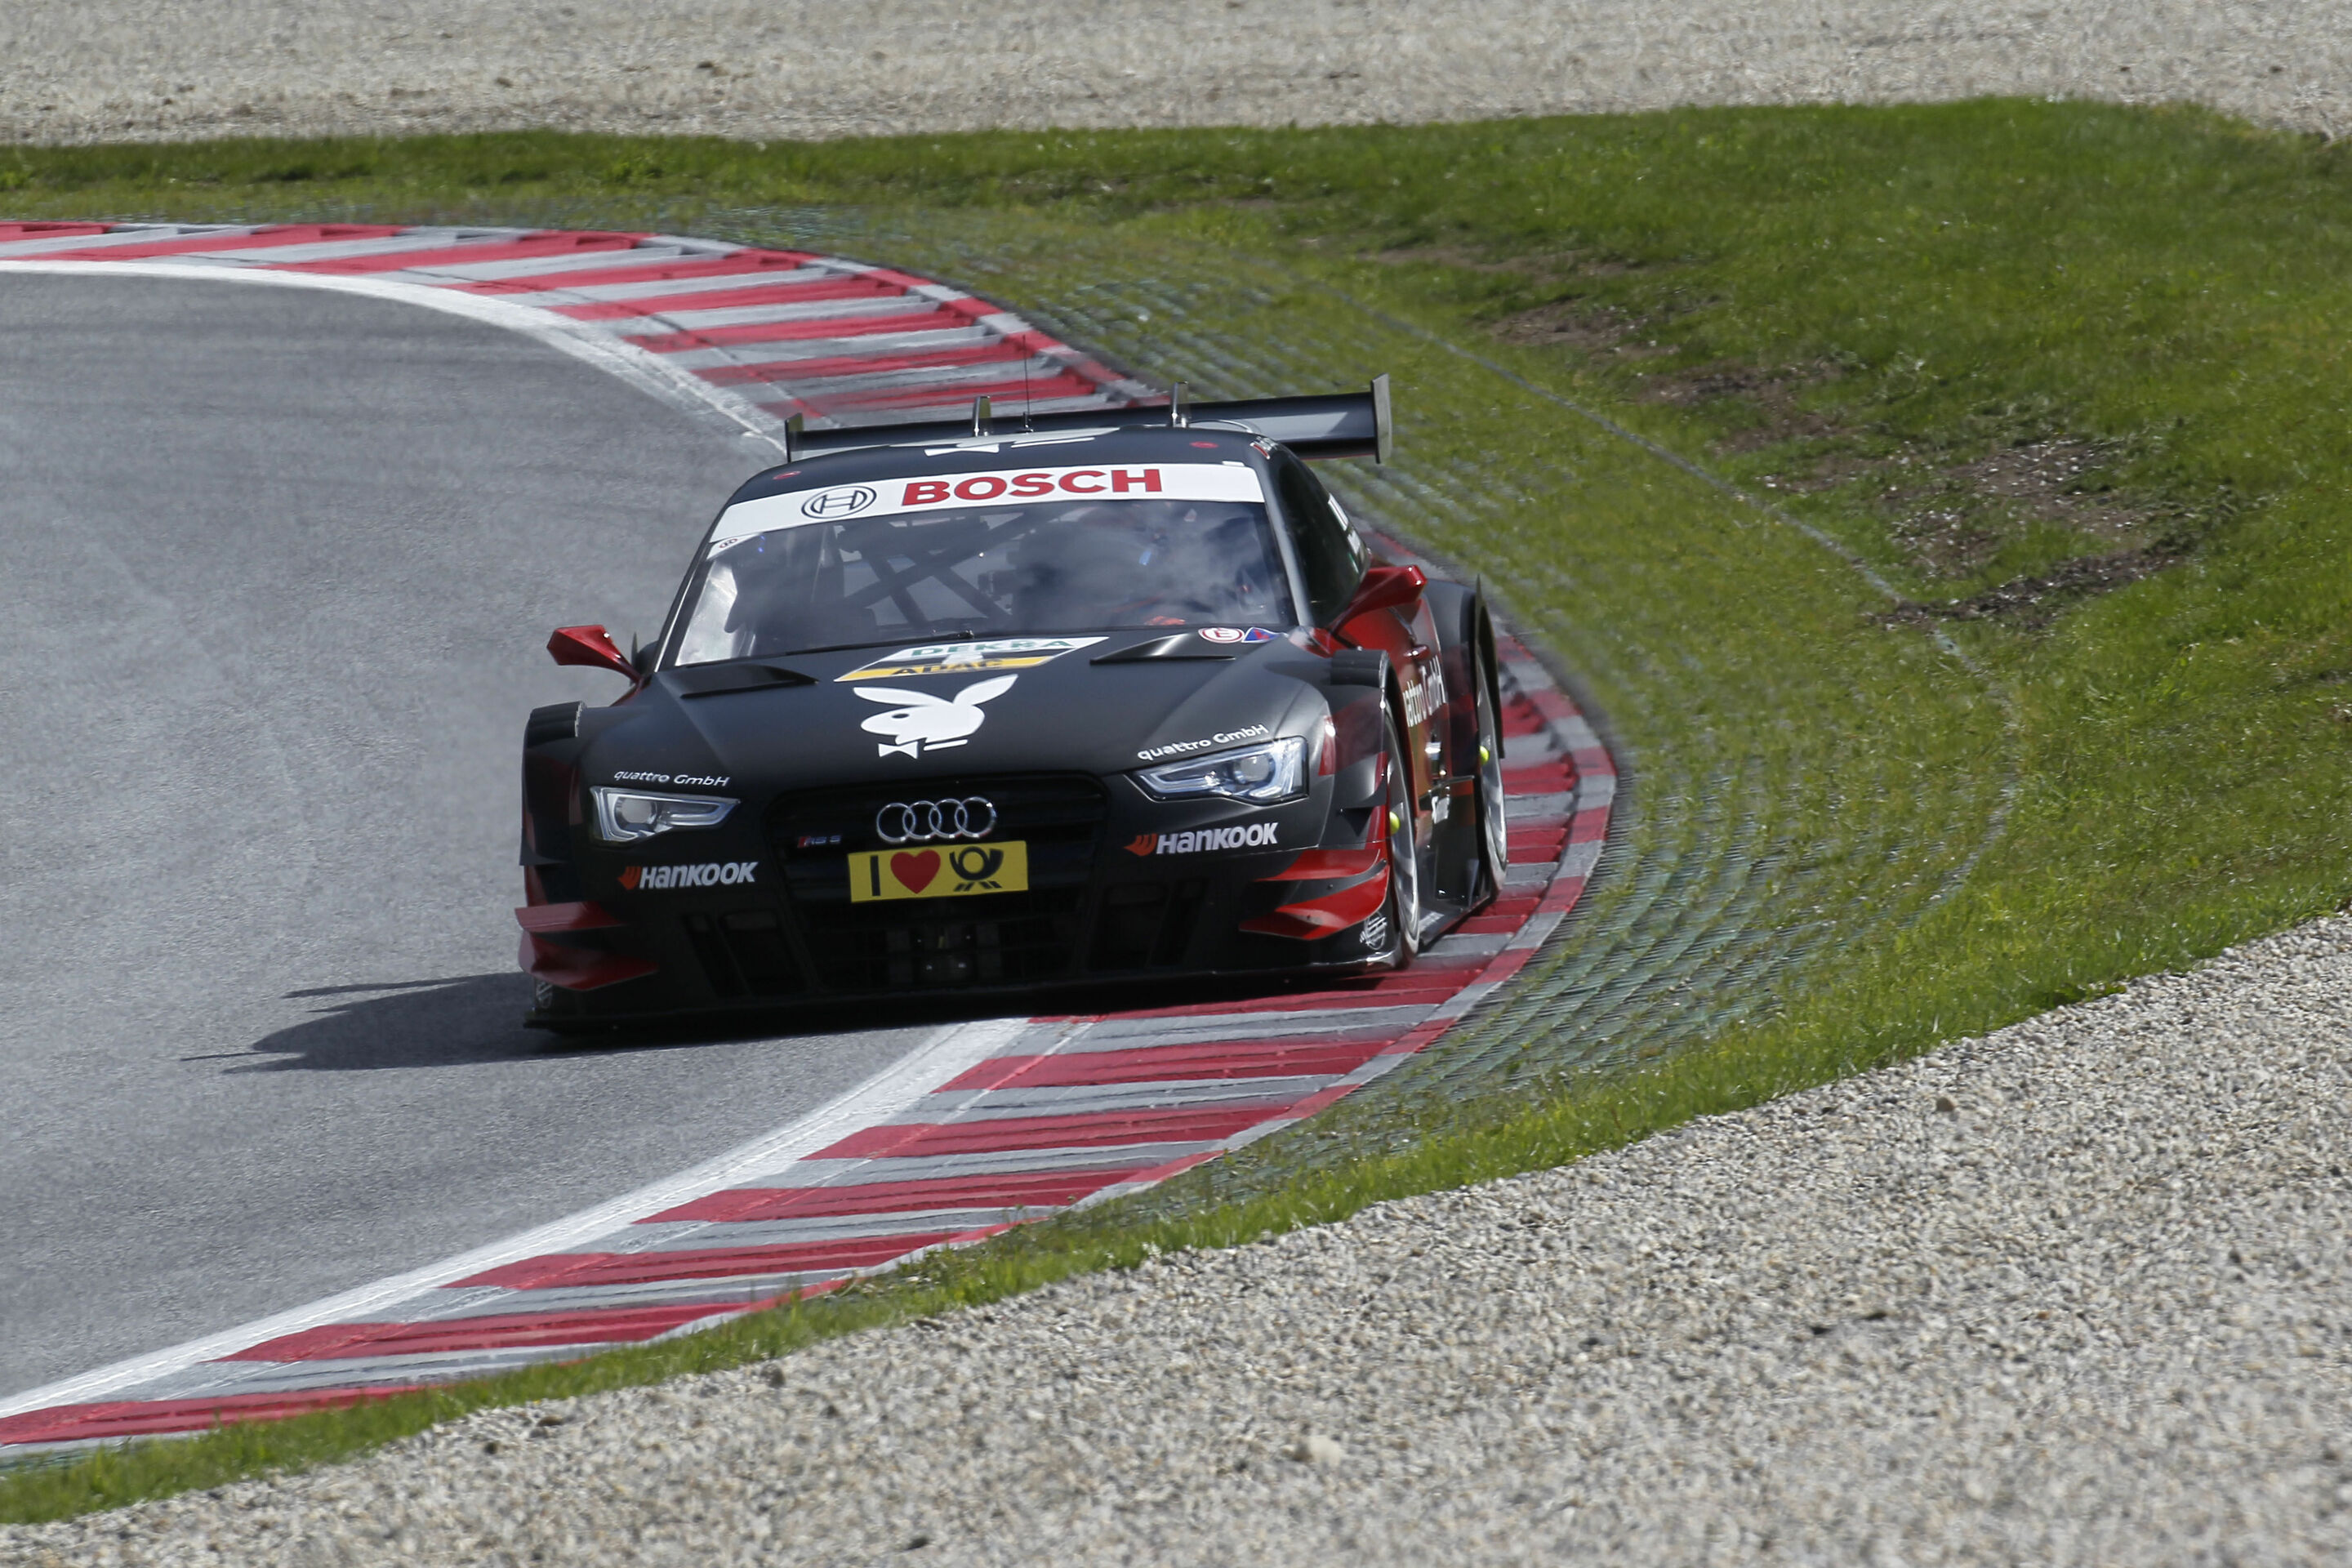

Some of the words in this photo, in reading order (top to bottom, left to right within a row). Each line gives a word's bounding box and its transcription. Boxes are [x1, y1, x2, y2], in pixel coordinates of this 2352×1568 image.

[901, 469, 1163, 506] BOSCH
[1137, 739, 1212, 761] quattro
[1213, 724, 1269, 744] GmbH
[613, 771, 670, 782] quattro
[673, 774, 730, 786] GmbH
[870, 855, 881, 897] I
